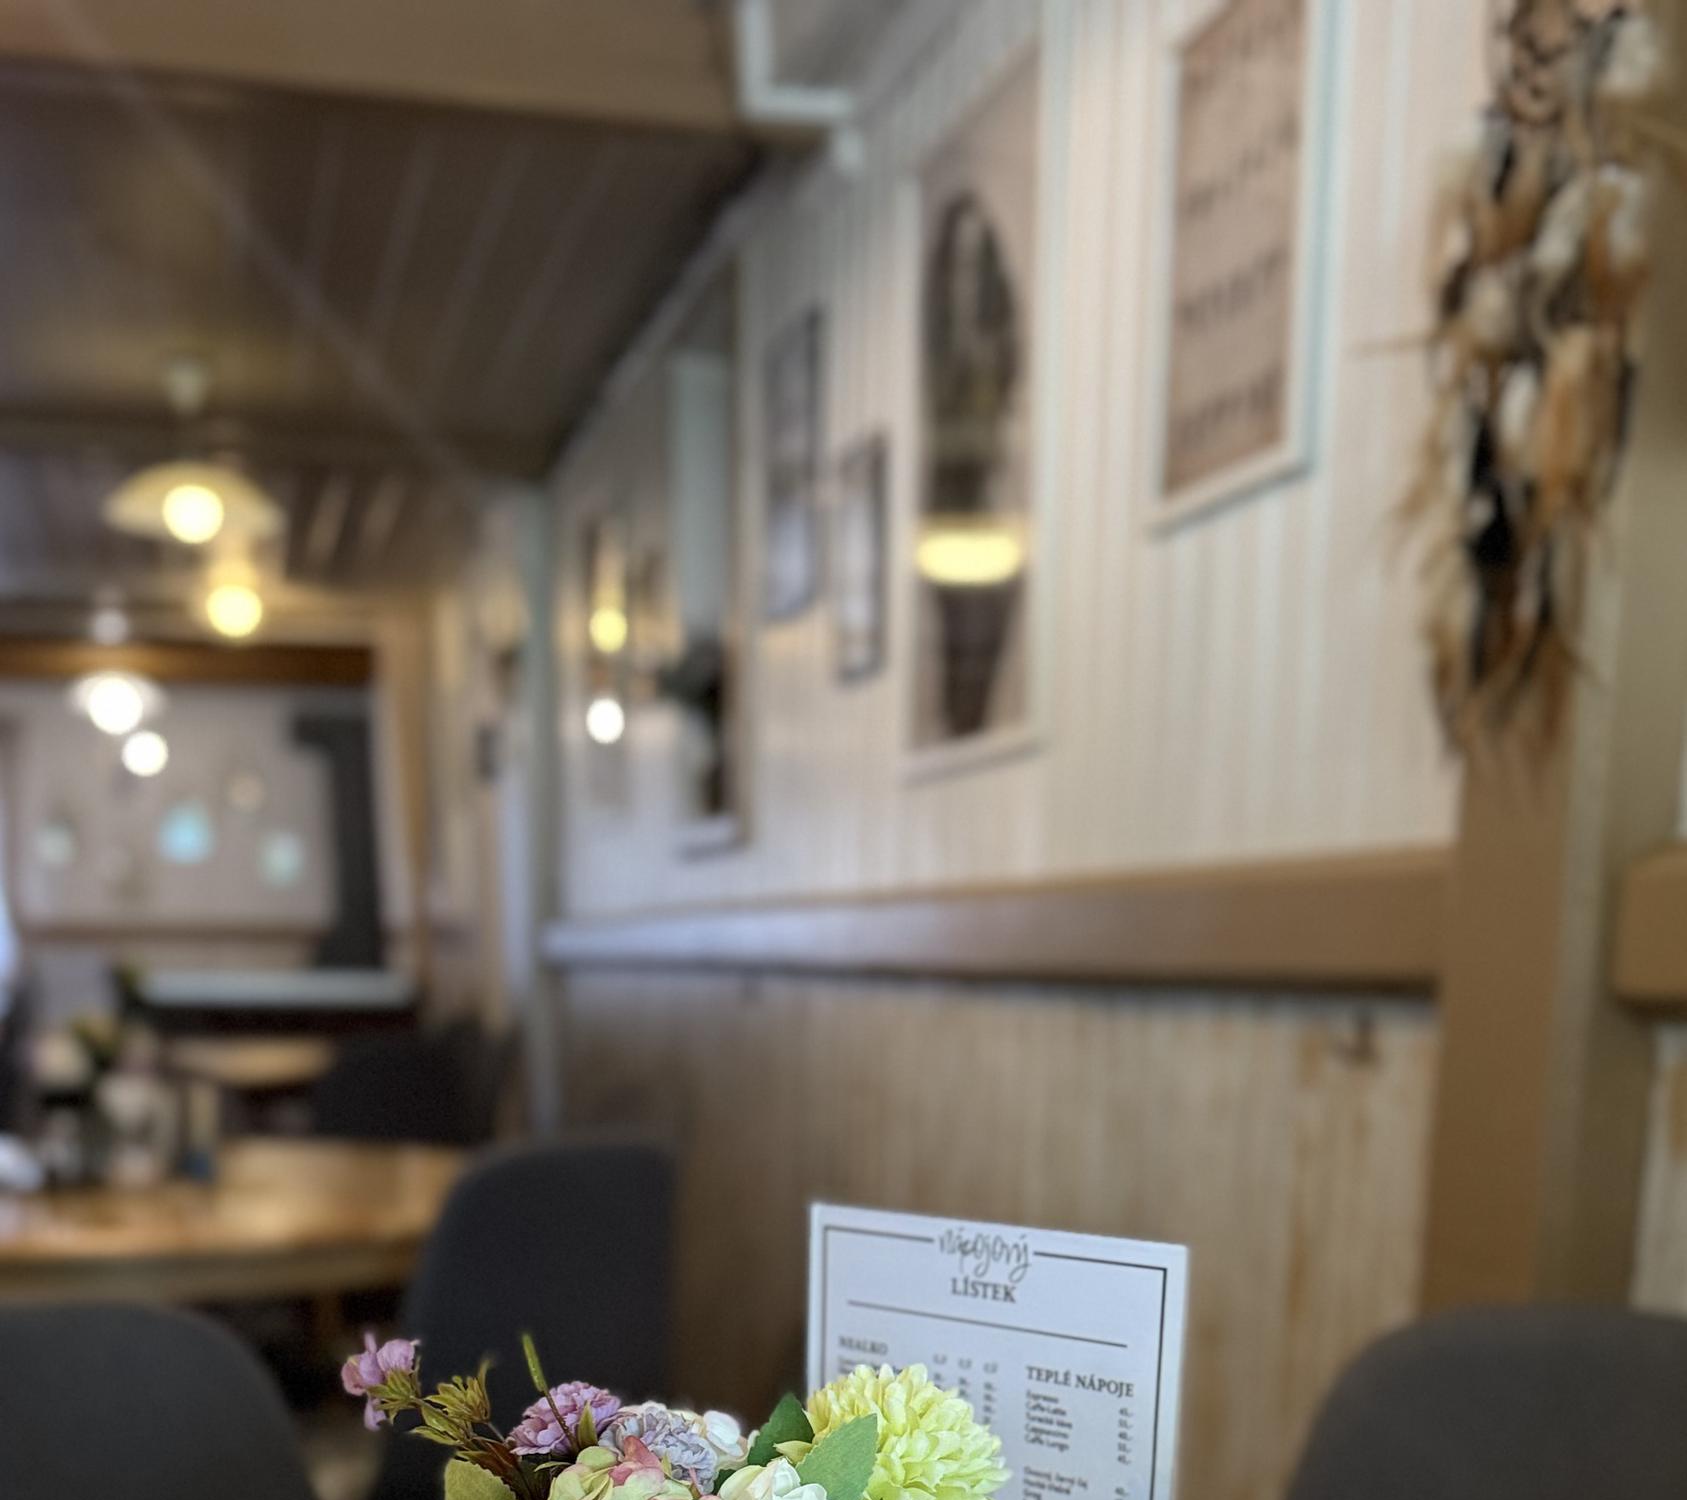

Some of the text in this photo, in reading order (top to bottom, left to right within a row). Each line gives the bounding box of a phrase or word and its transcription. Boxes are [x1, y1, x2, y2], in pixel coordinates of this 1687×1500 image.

[950, 1276, 1017, 1305] LÍSTEK
[1026, 1366, 1134, 1398] TEPLÉ NÁPOJE
